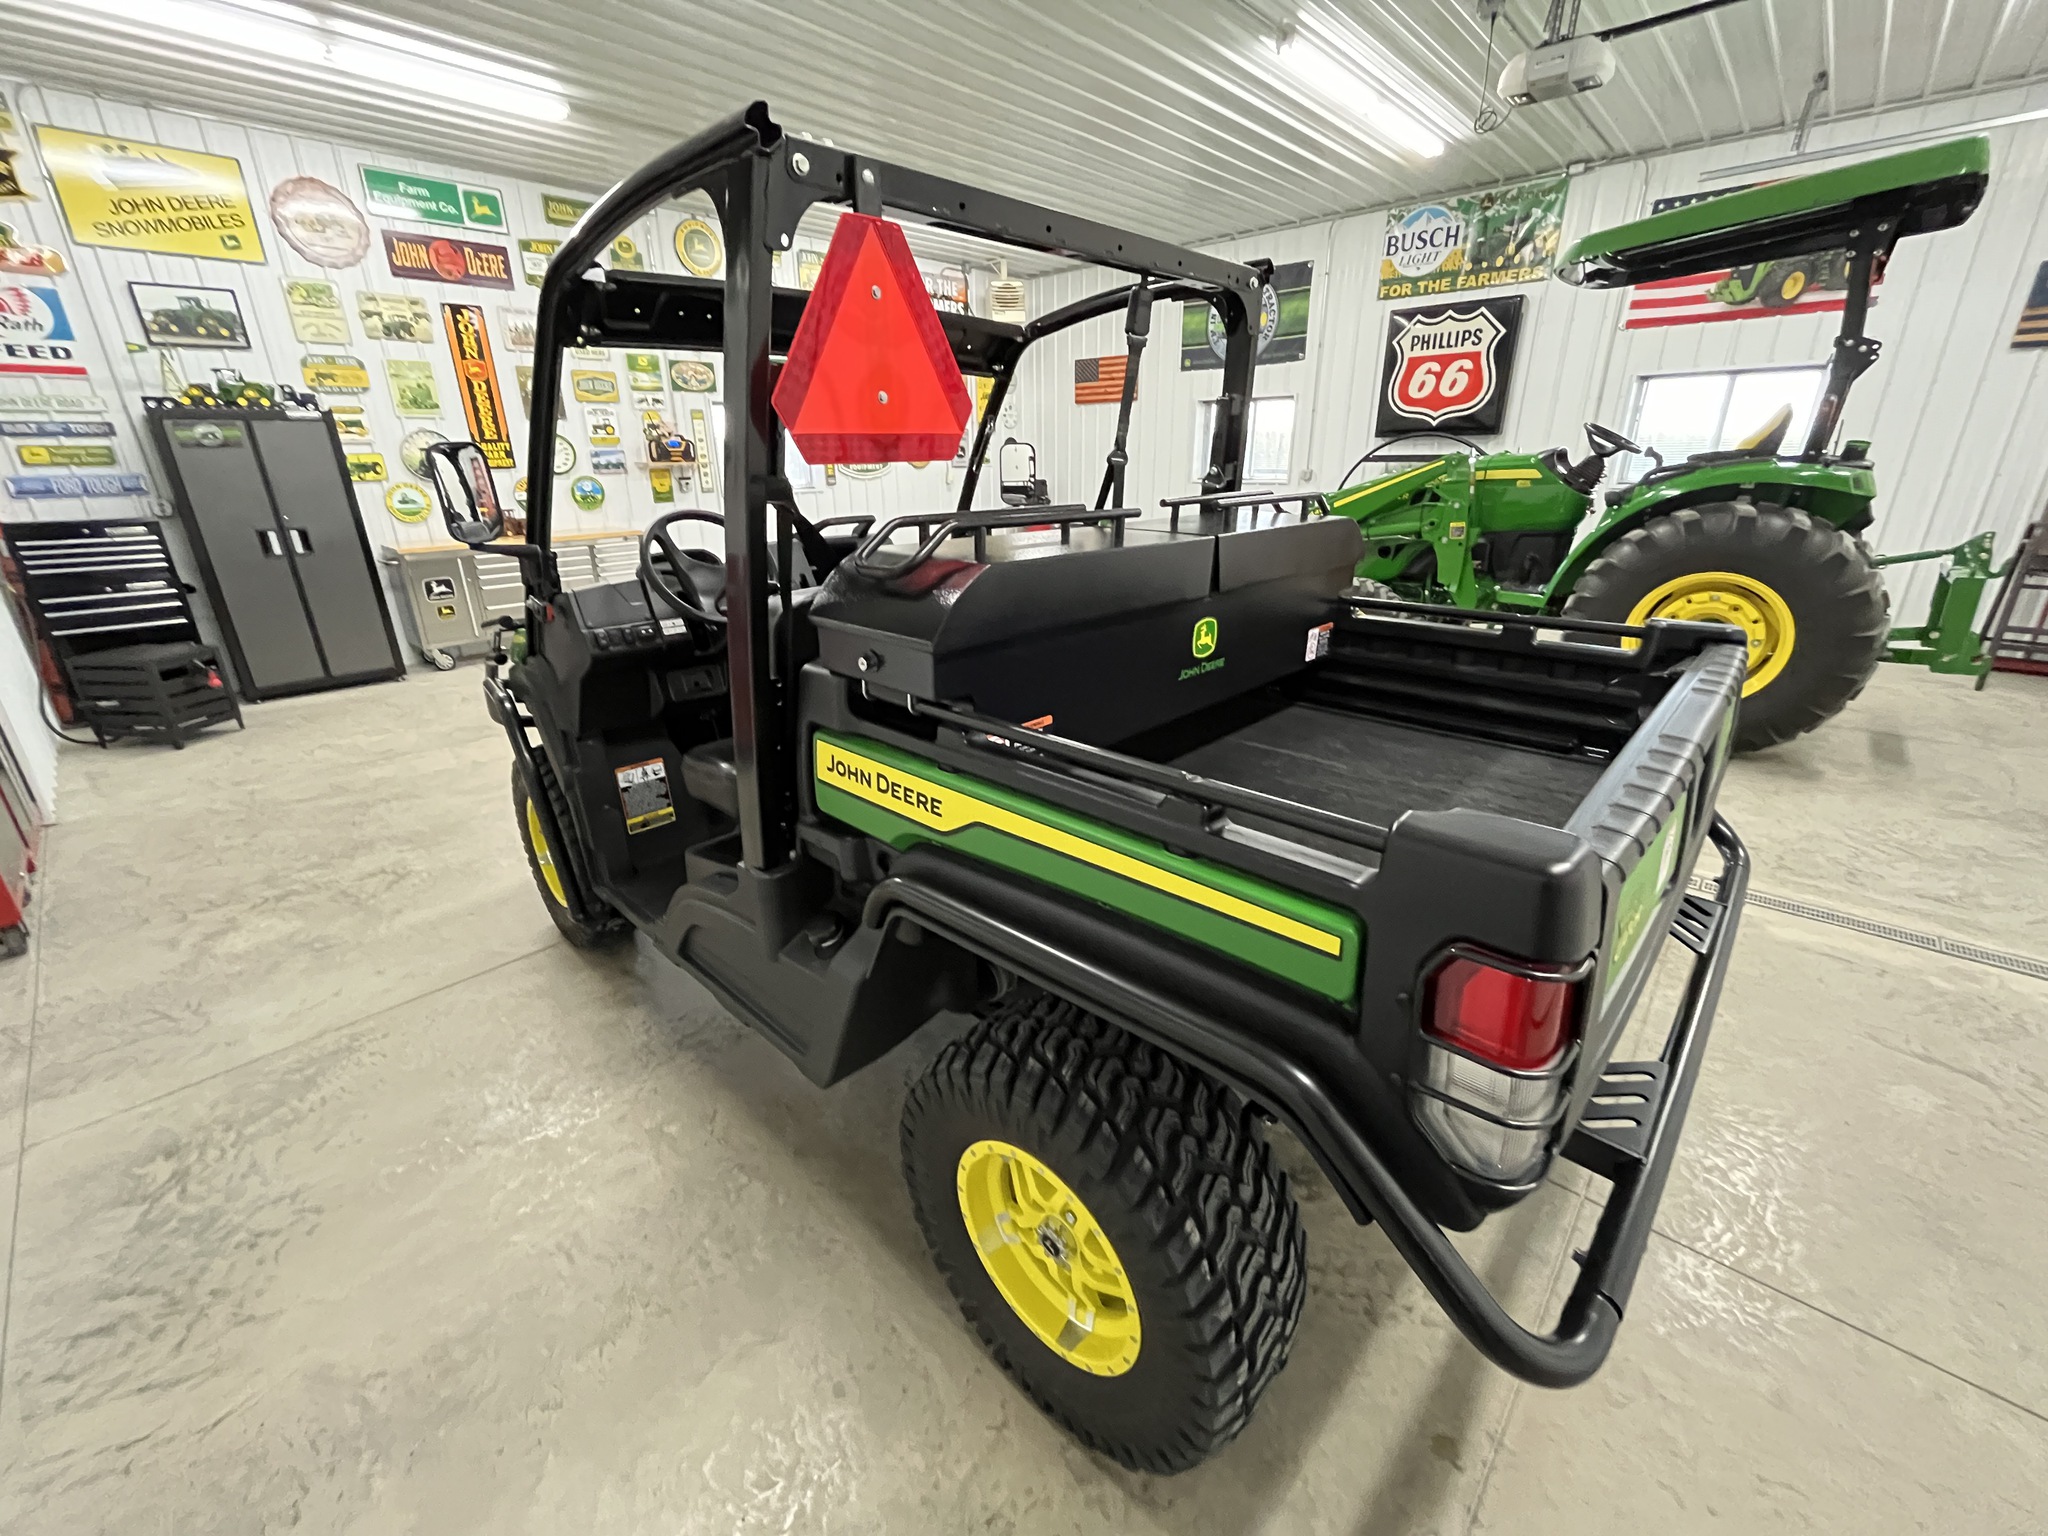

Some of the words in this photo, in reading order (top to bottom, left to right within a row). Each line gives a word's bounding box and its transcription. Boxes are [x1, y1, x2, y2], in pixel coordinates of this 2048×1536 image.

[108, 196, 167, 216] JOHN
[165, 194, 237, 212] DEERE
[398, 181, 430, 198] Farm
[92, 213, 246, 238] SNOWMOBILES
[1386, 225, 1460, 257] BUSCH
[392, 237, 431, 270] JOHN
[463, 246, 509, 279] DEERE
[1399, 251, 1442, 267] LIGHT
[936, 278, 958, 297] THE
[1380, 283, 1412, 299] FOR
[1417, 278, 1452, 294] THE
[1456, 266, 1545, 290] FARMERS
[1262, 286, 1277, 342] TRACTOR
[456, 308, 479, 360] JOHN
[1410, 328, 1483, 352] PHILLIPS
[1408, 358, 1474, 399] 66
[472, 380, 499, 440] DEERE
[1178, 665, 1200, 681] JOHN
[826, 754, 872, 789] JOHN
[876, 771, 943, 818] DEERE
